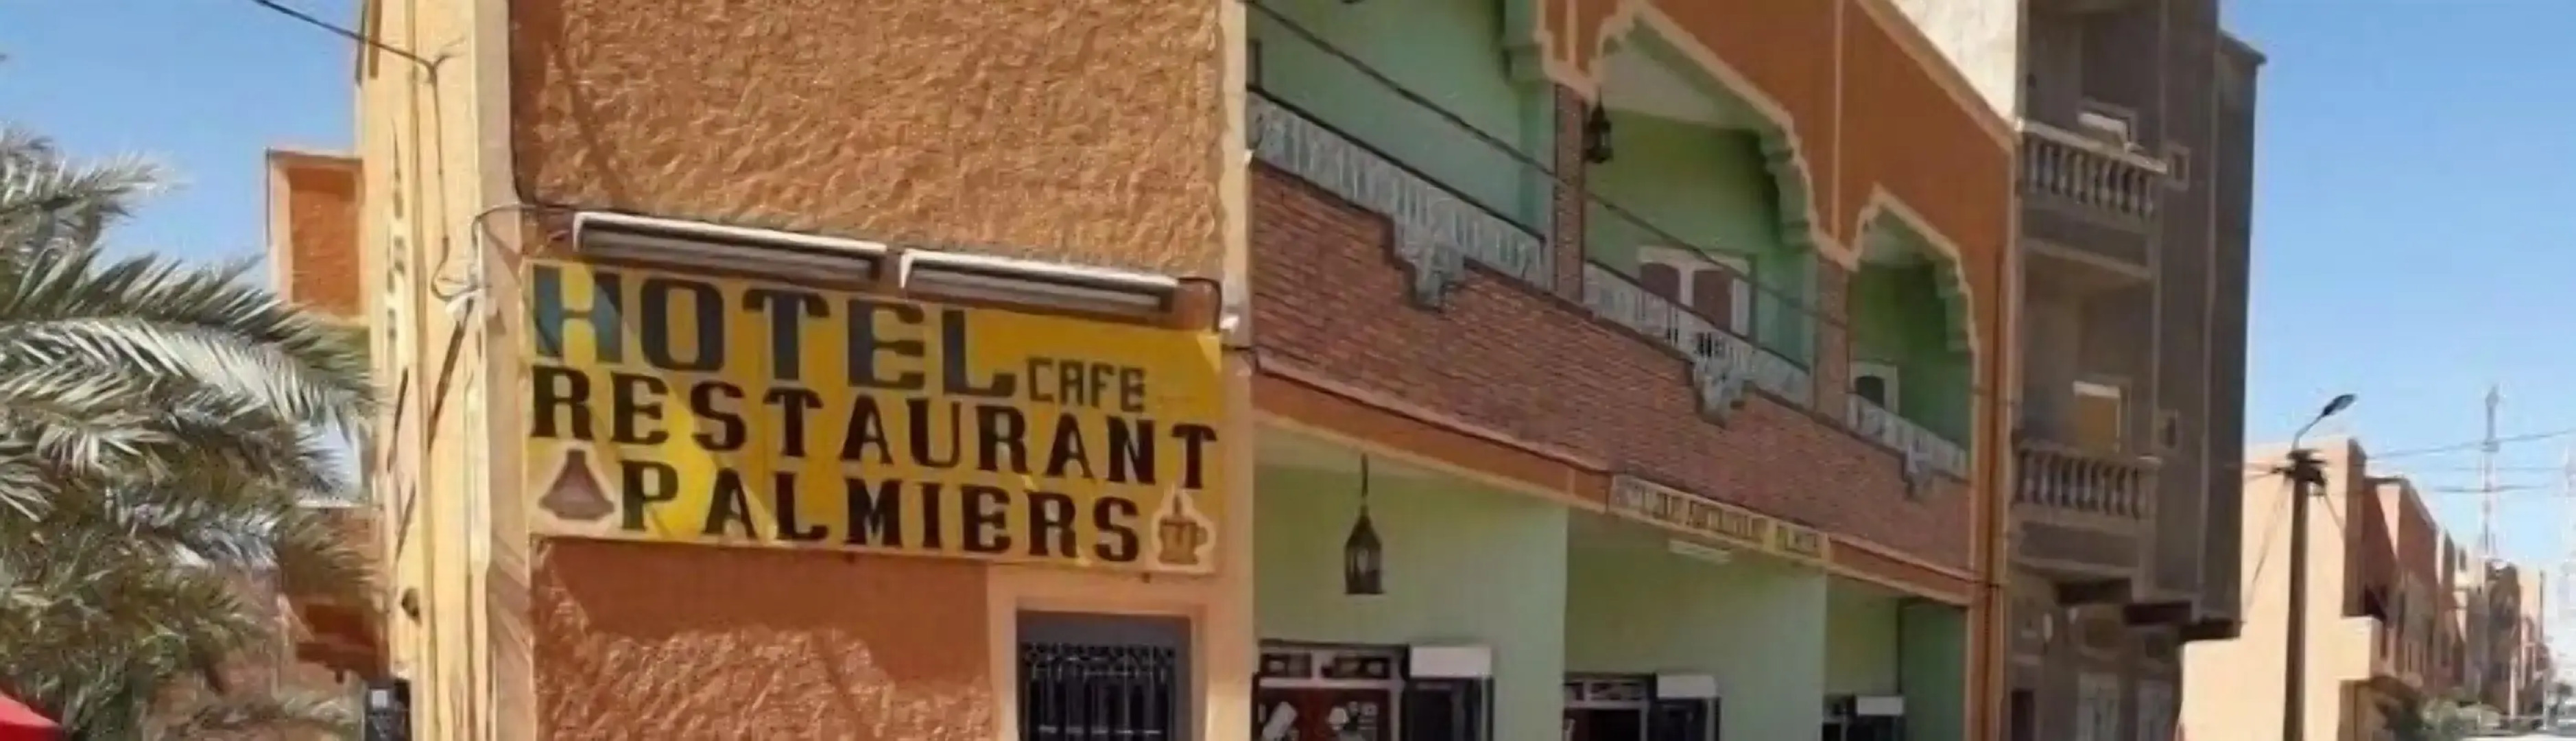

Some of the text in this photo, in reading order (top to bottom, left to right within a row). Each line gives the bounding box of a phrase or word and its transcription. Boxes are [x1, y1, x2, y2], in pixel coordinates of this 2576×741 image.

[533, 264, 1016, 398] HOTEL
[1027, 356, 1146, 414] CAFE
[530, 364, 1217, 490] RESTAURANT
[619, 459, 1141, 563] PALMIERS
